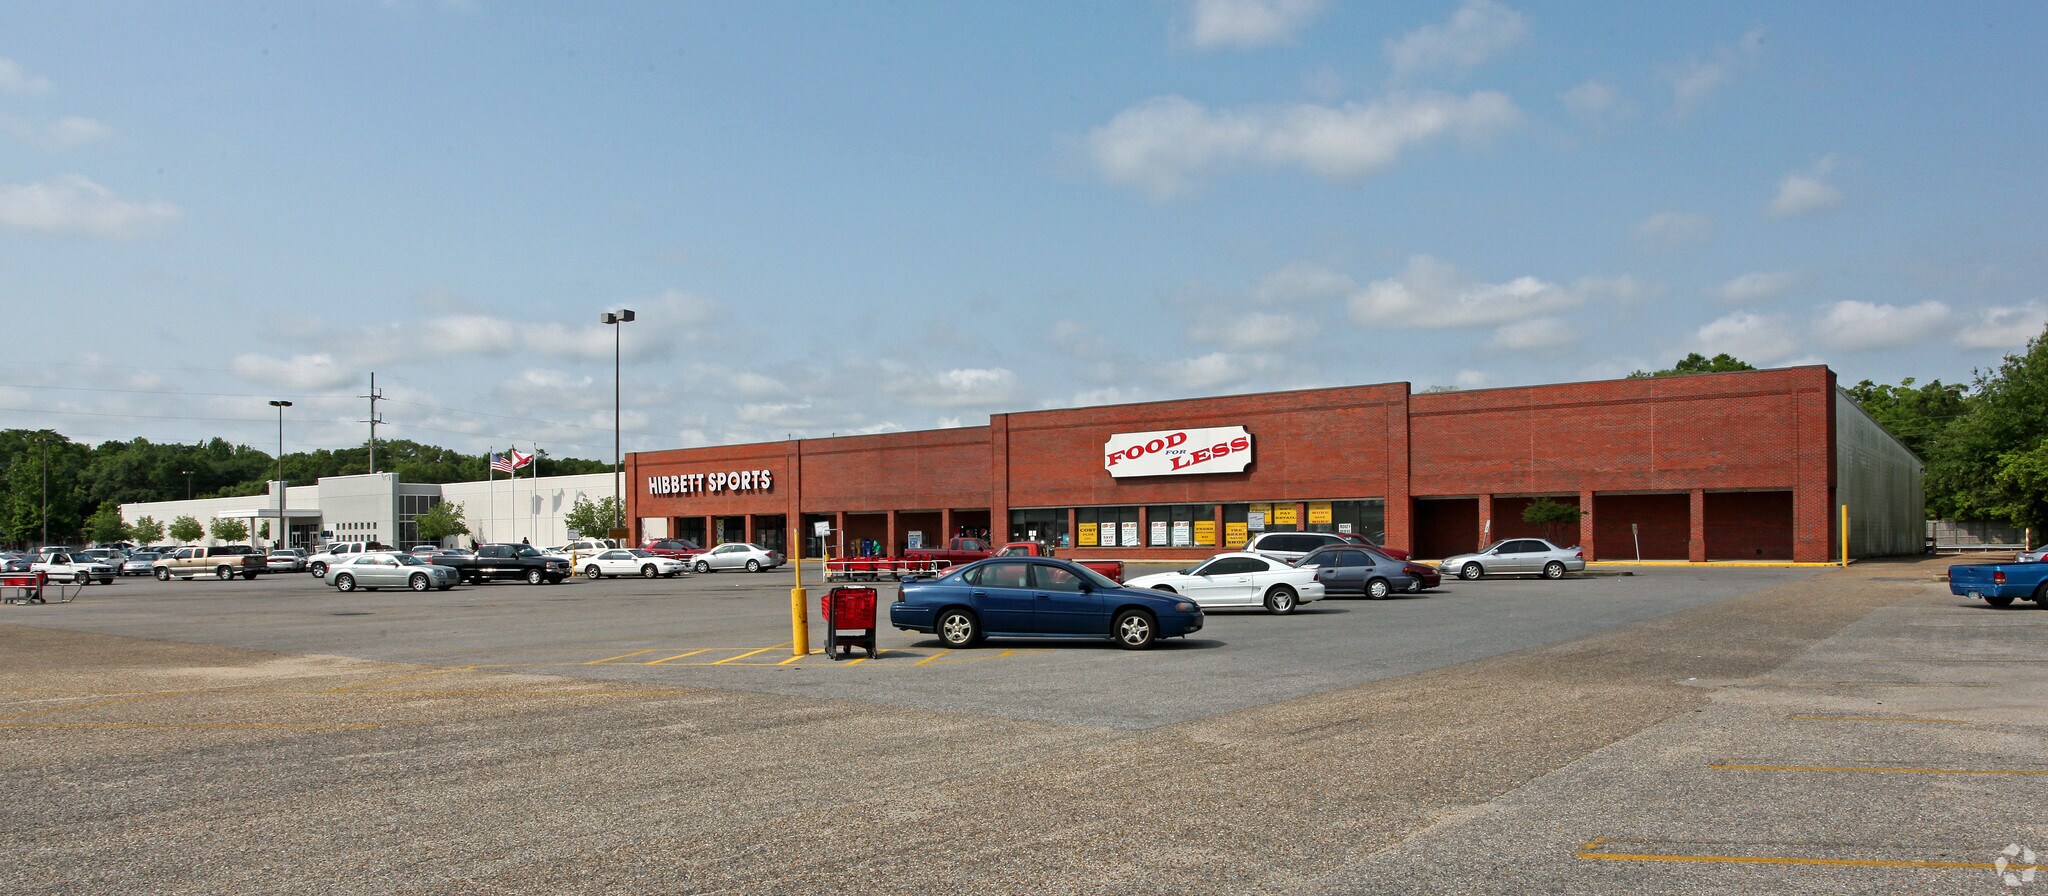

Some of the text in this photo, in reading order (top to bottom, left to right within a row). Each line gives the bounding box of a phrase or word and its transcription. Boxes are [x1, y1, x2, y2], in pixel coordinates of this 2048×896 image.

[1107, 432, 1187, 466] FOOD
[1170, 436, 1249, 471] LESS
[648, 469, 771, 494] HIBBETT SPORTS
